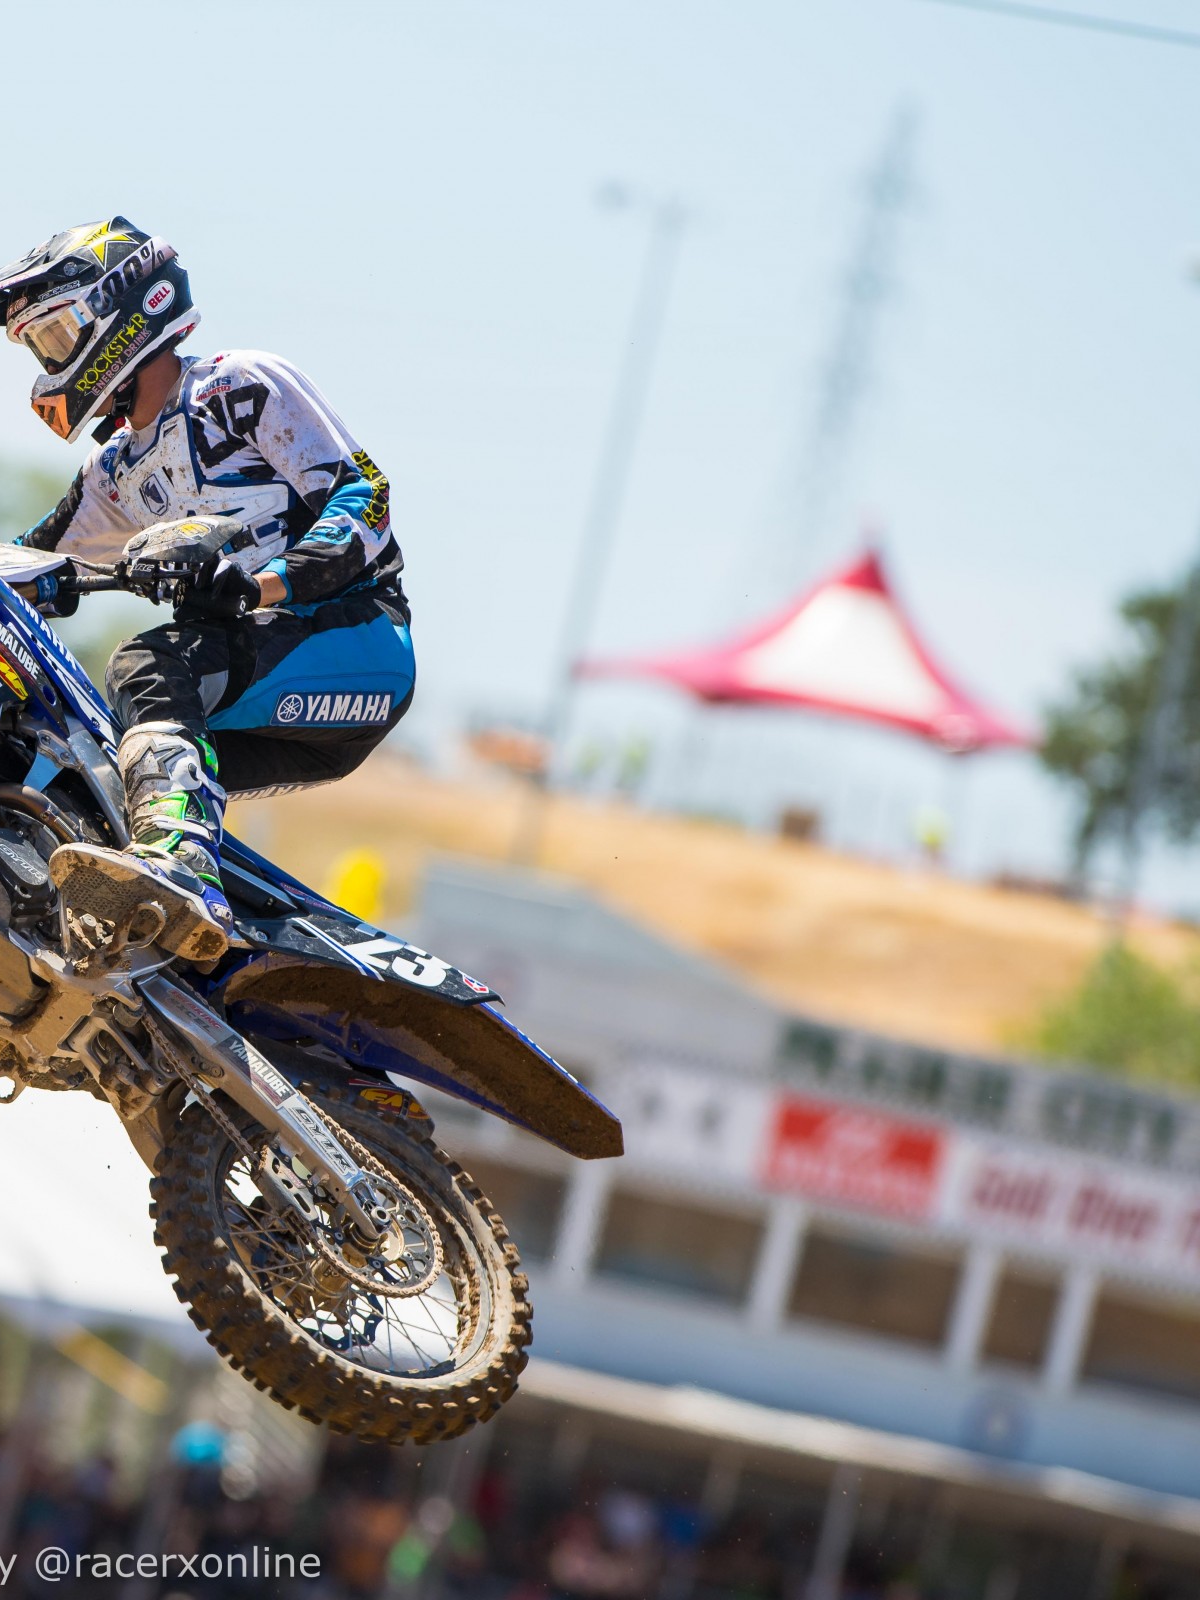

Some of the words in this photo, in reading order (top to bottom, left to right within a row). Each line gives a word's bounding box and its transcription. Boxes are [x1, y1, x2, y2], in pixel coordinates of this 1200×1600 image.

[148, 286, 171, 310] BELL
[92, 357, 124, 395] ENERGY
[123, 330, 150, 358] DRINK
[305, 694, 391, 722] YAMAHA
[343, 938, 452, 987] 23
[228, 1040, 290, 1097] YAMALUBE
[292, 1107, 353, 1171] GYTR
